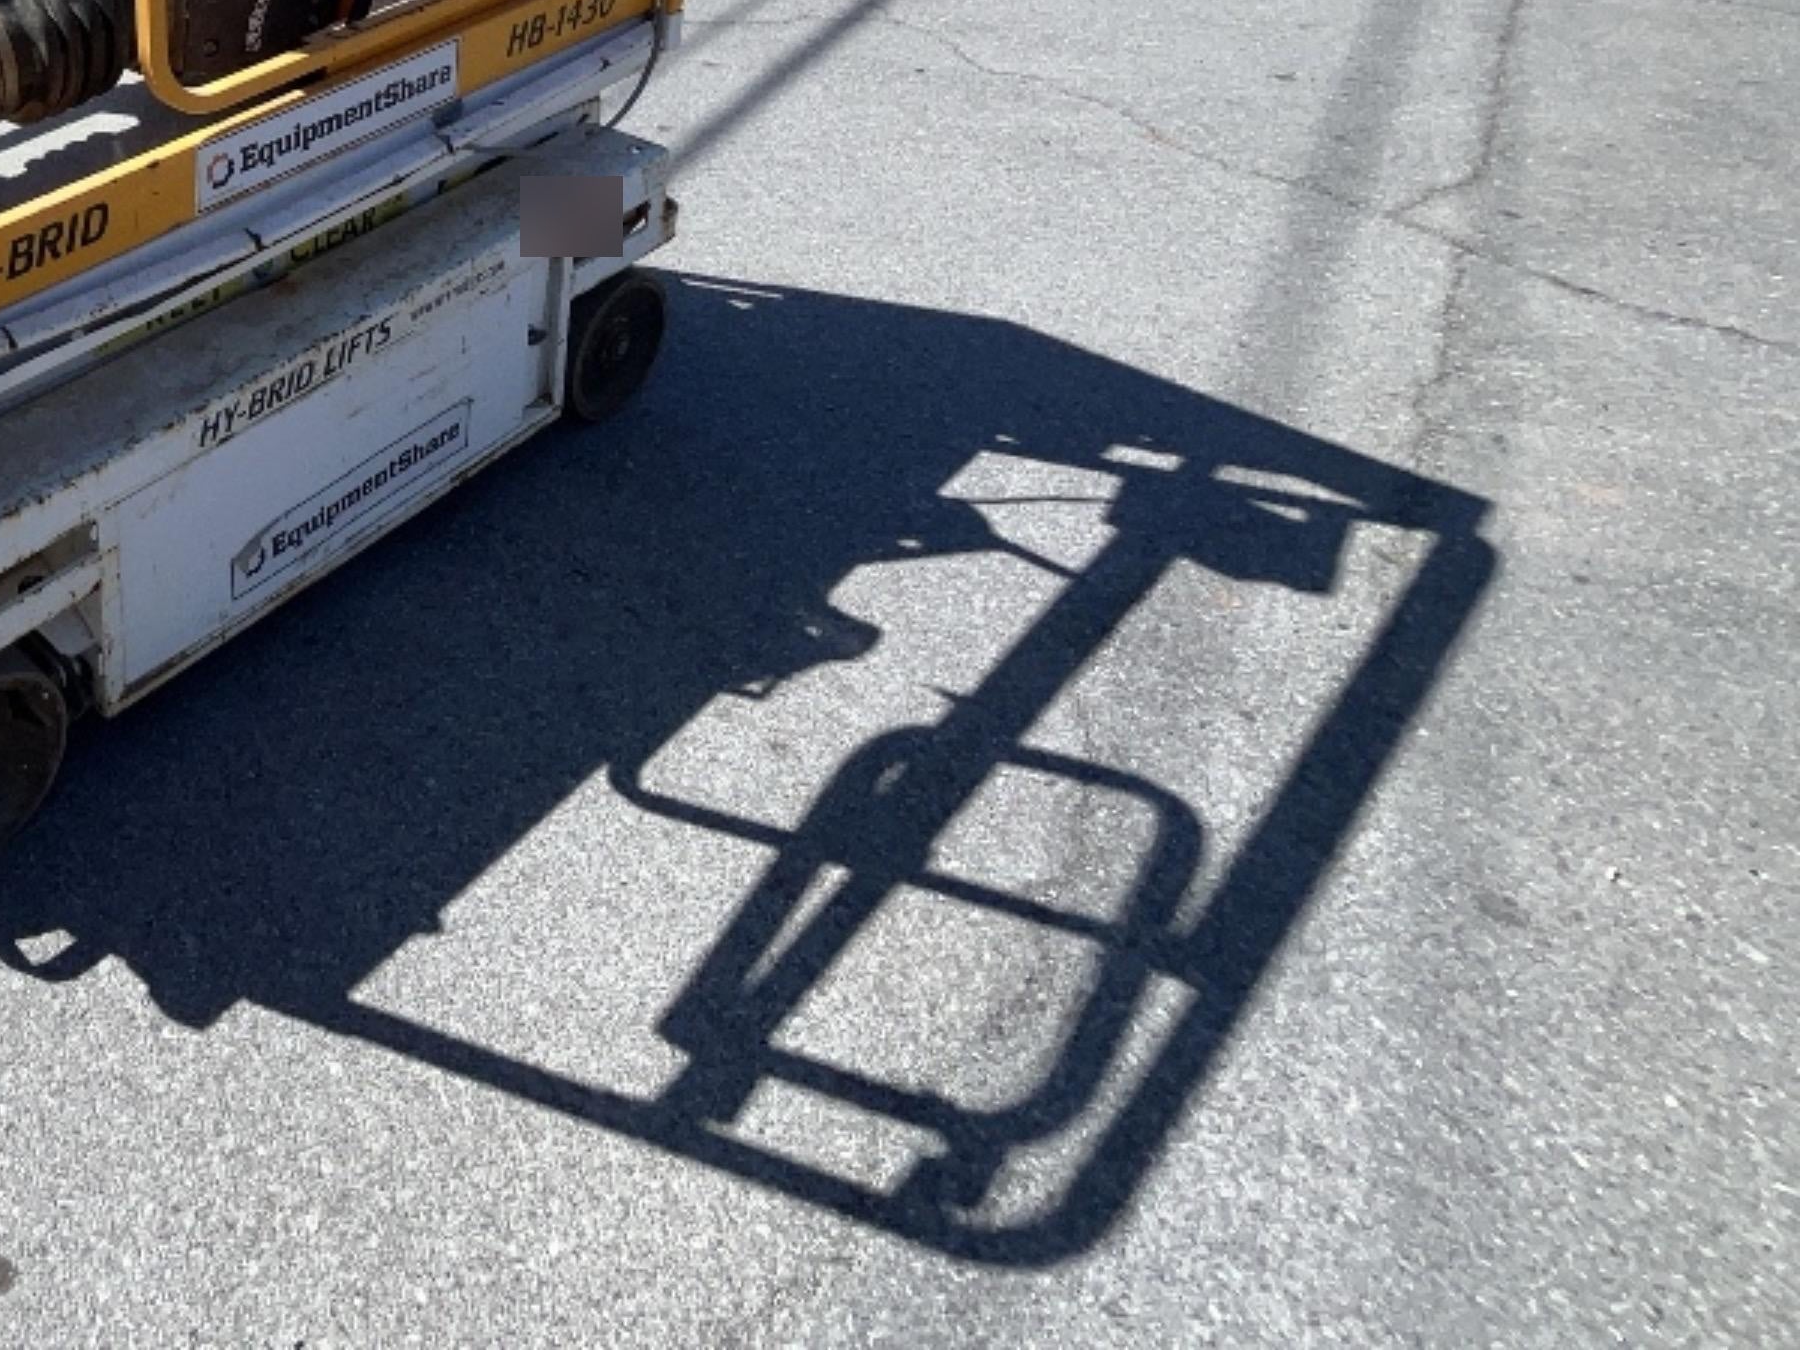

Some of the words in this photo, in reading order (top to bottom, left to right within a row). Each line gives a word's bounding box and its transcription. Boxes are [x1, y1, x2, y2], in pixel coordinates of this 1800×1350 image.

[239, 64, 452, 173] EquipmentShare
[199, 360, 314, 448] HY-BRID
[322, 312, 395, 377] LIFTS
[271, 421, 461, 559] EquipmentShare
